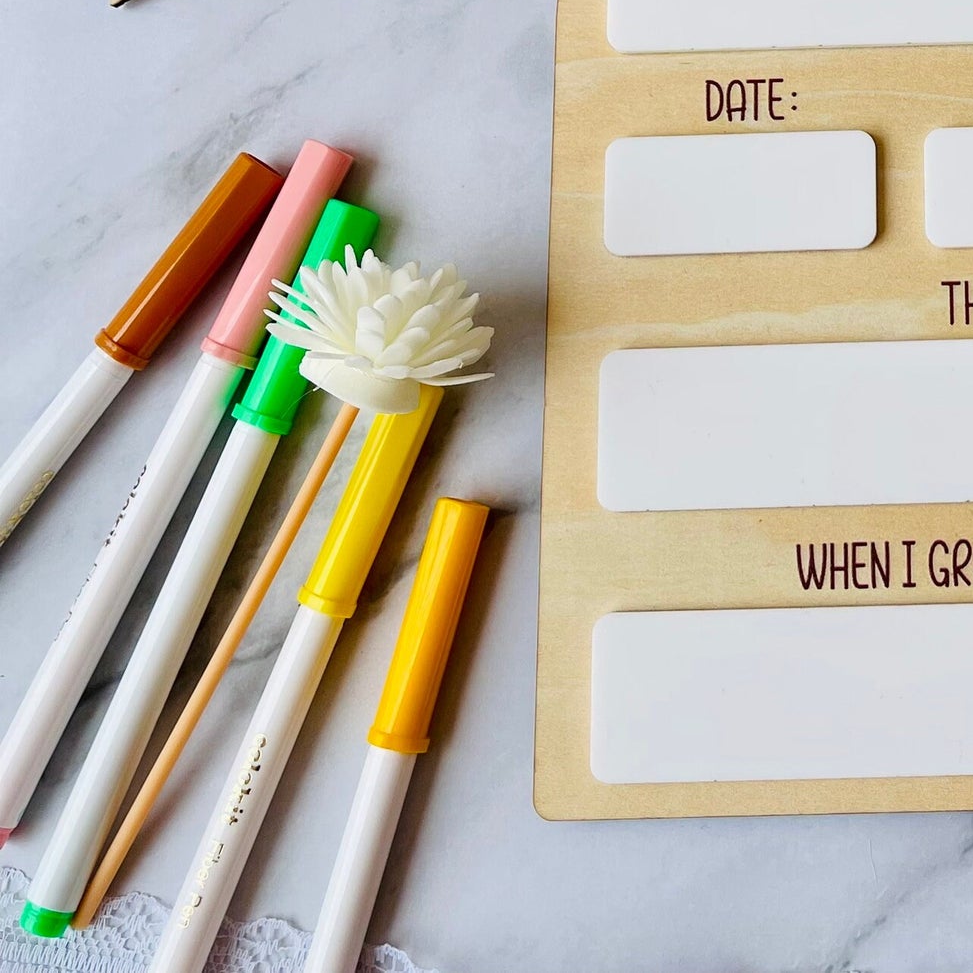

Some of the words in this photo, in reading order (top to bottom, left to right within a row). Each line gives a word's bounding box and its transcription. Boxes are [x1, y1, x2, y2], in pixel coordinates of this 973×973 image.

[705, 78, 798, 122] DATE:
[796, 540, 890, 591] WHEN
[901, 540, 917, 588] I
